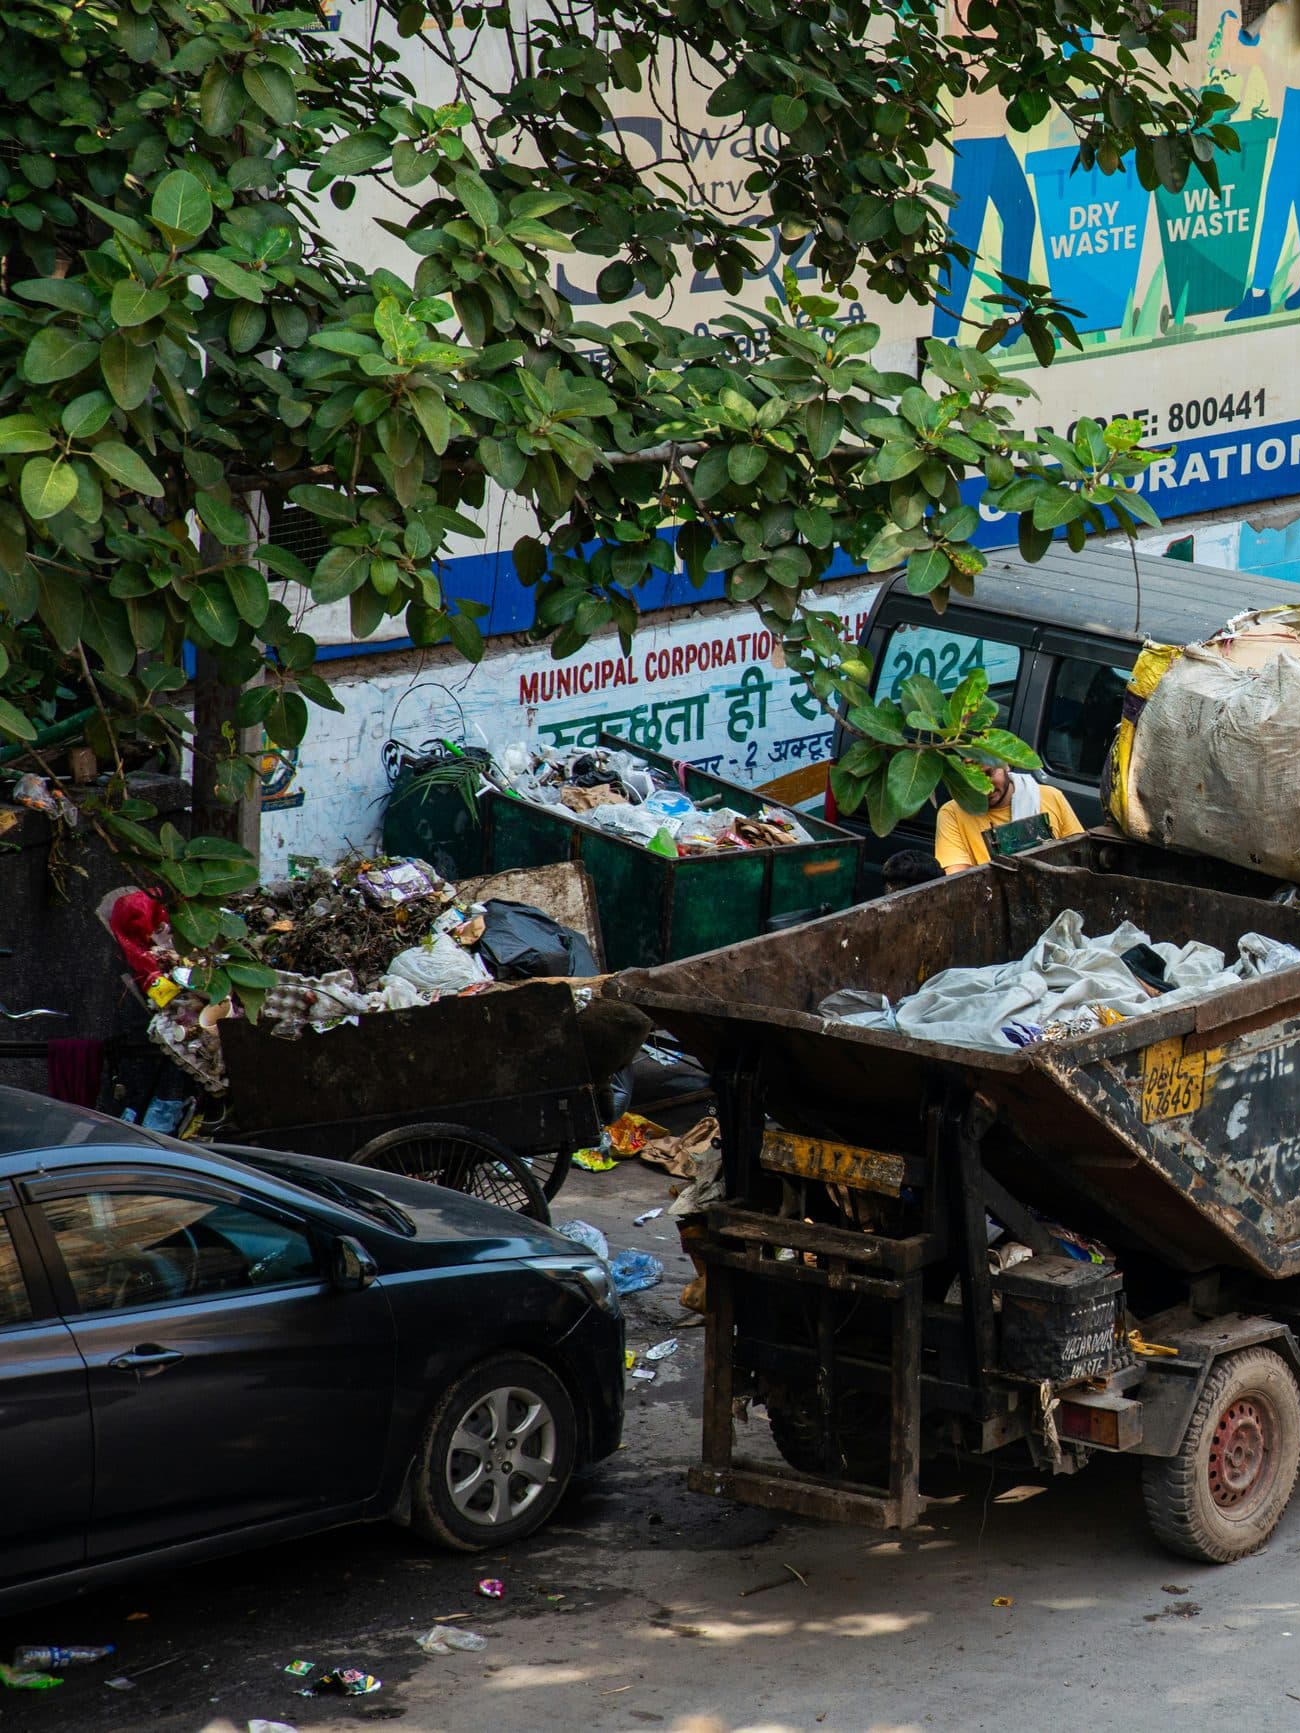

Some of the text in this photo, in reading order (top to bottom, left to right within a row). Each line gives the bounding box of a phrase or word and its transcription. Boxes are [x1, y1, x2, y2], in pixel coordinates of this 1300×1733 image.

[1069, 201, 1120, 231] DRY
[1184, 184, 1236, 214] WET
[1051, 224, 1137, 260] WASTE
[1166, 207, 1250, 243] WASTE
[1168, 388, 1266, 433] 800441
[519, 656, 638, 705] MUNICIPAL
